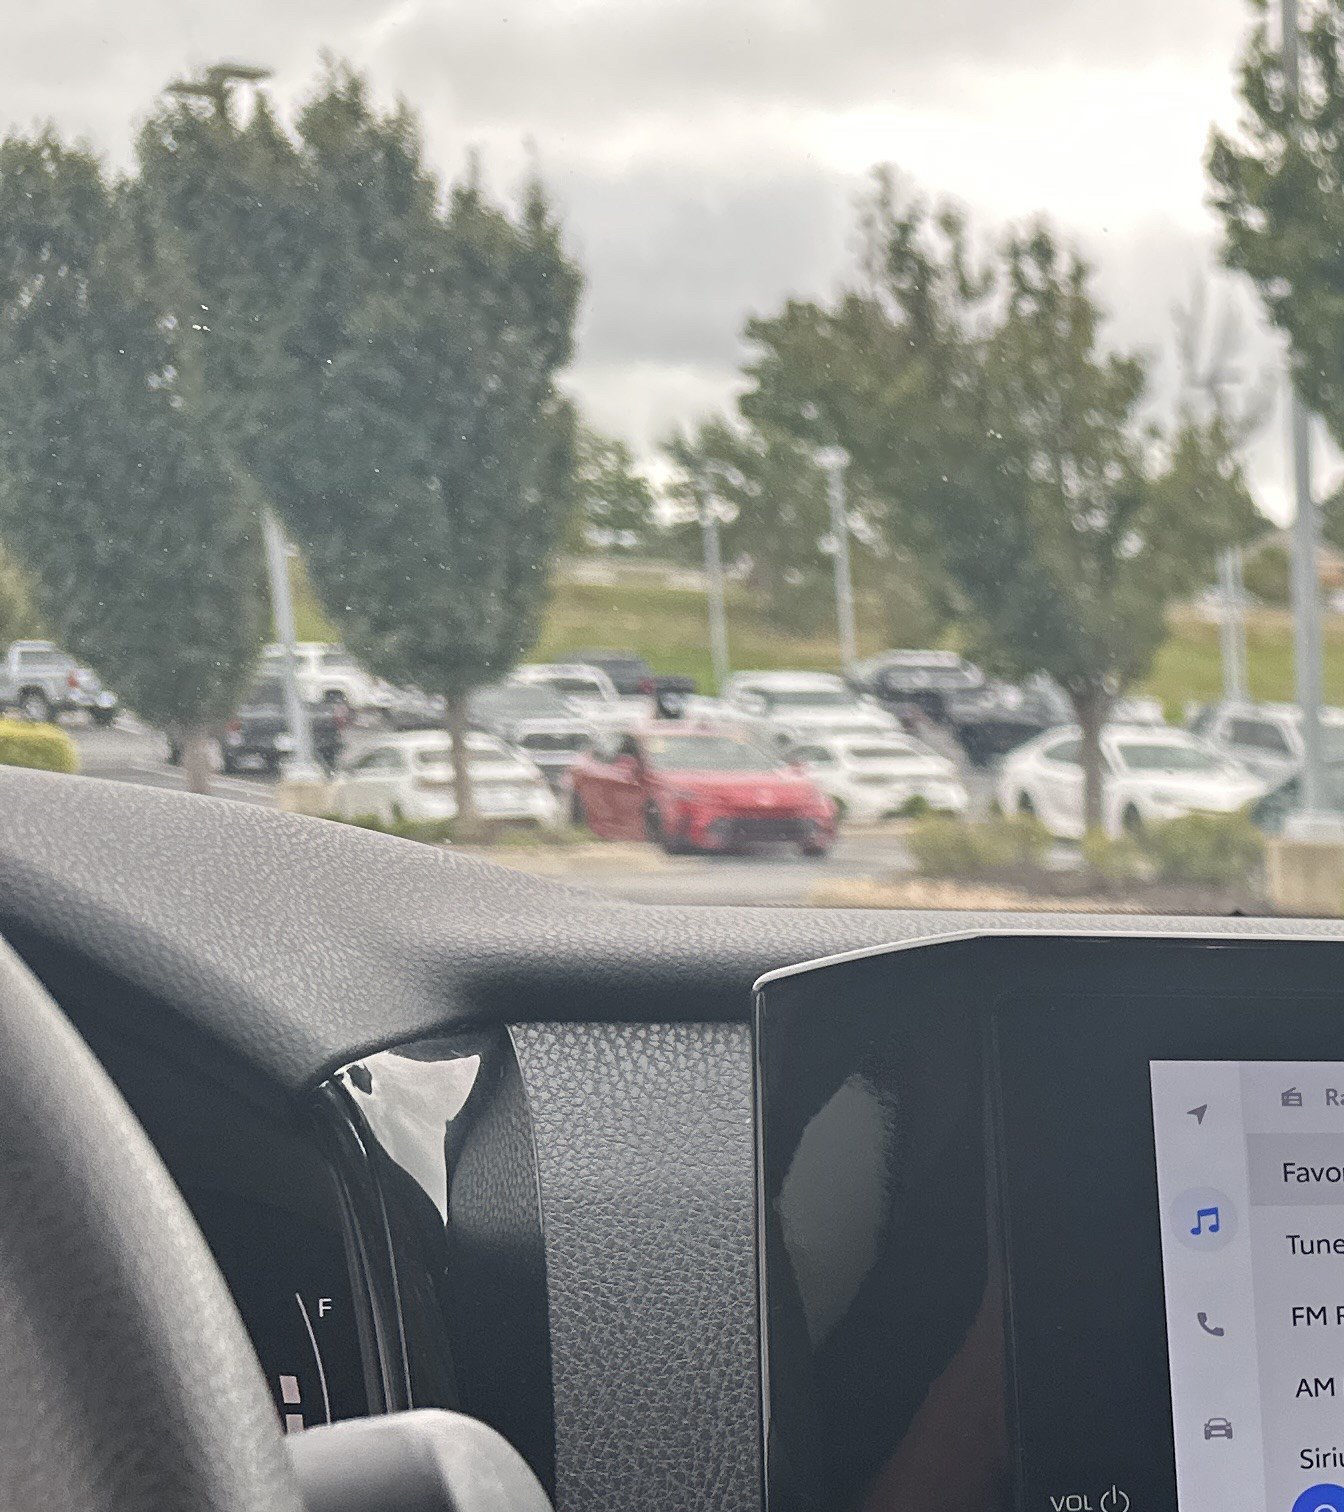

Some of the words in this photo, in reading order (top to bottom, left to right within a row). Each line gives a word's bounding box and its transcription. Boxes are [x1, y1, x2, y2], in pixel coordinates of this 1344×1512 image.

[318, 1298, 332, 1318] F
[1290, 1305, 1328, 1327] FM
[1295, 1376, 1336, 1399] AM
[1050, 1494, 1093, 1512] VOL
